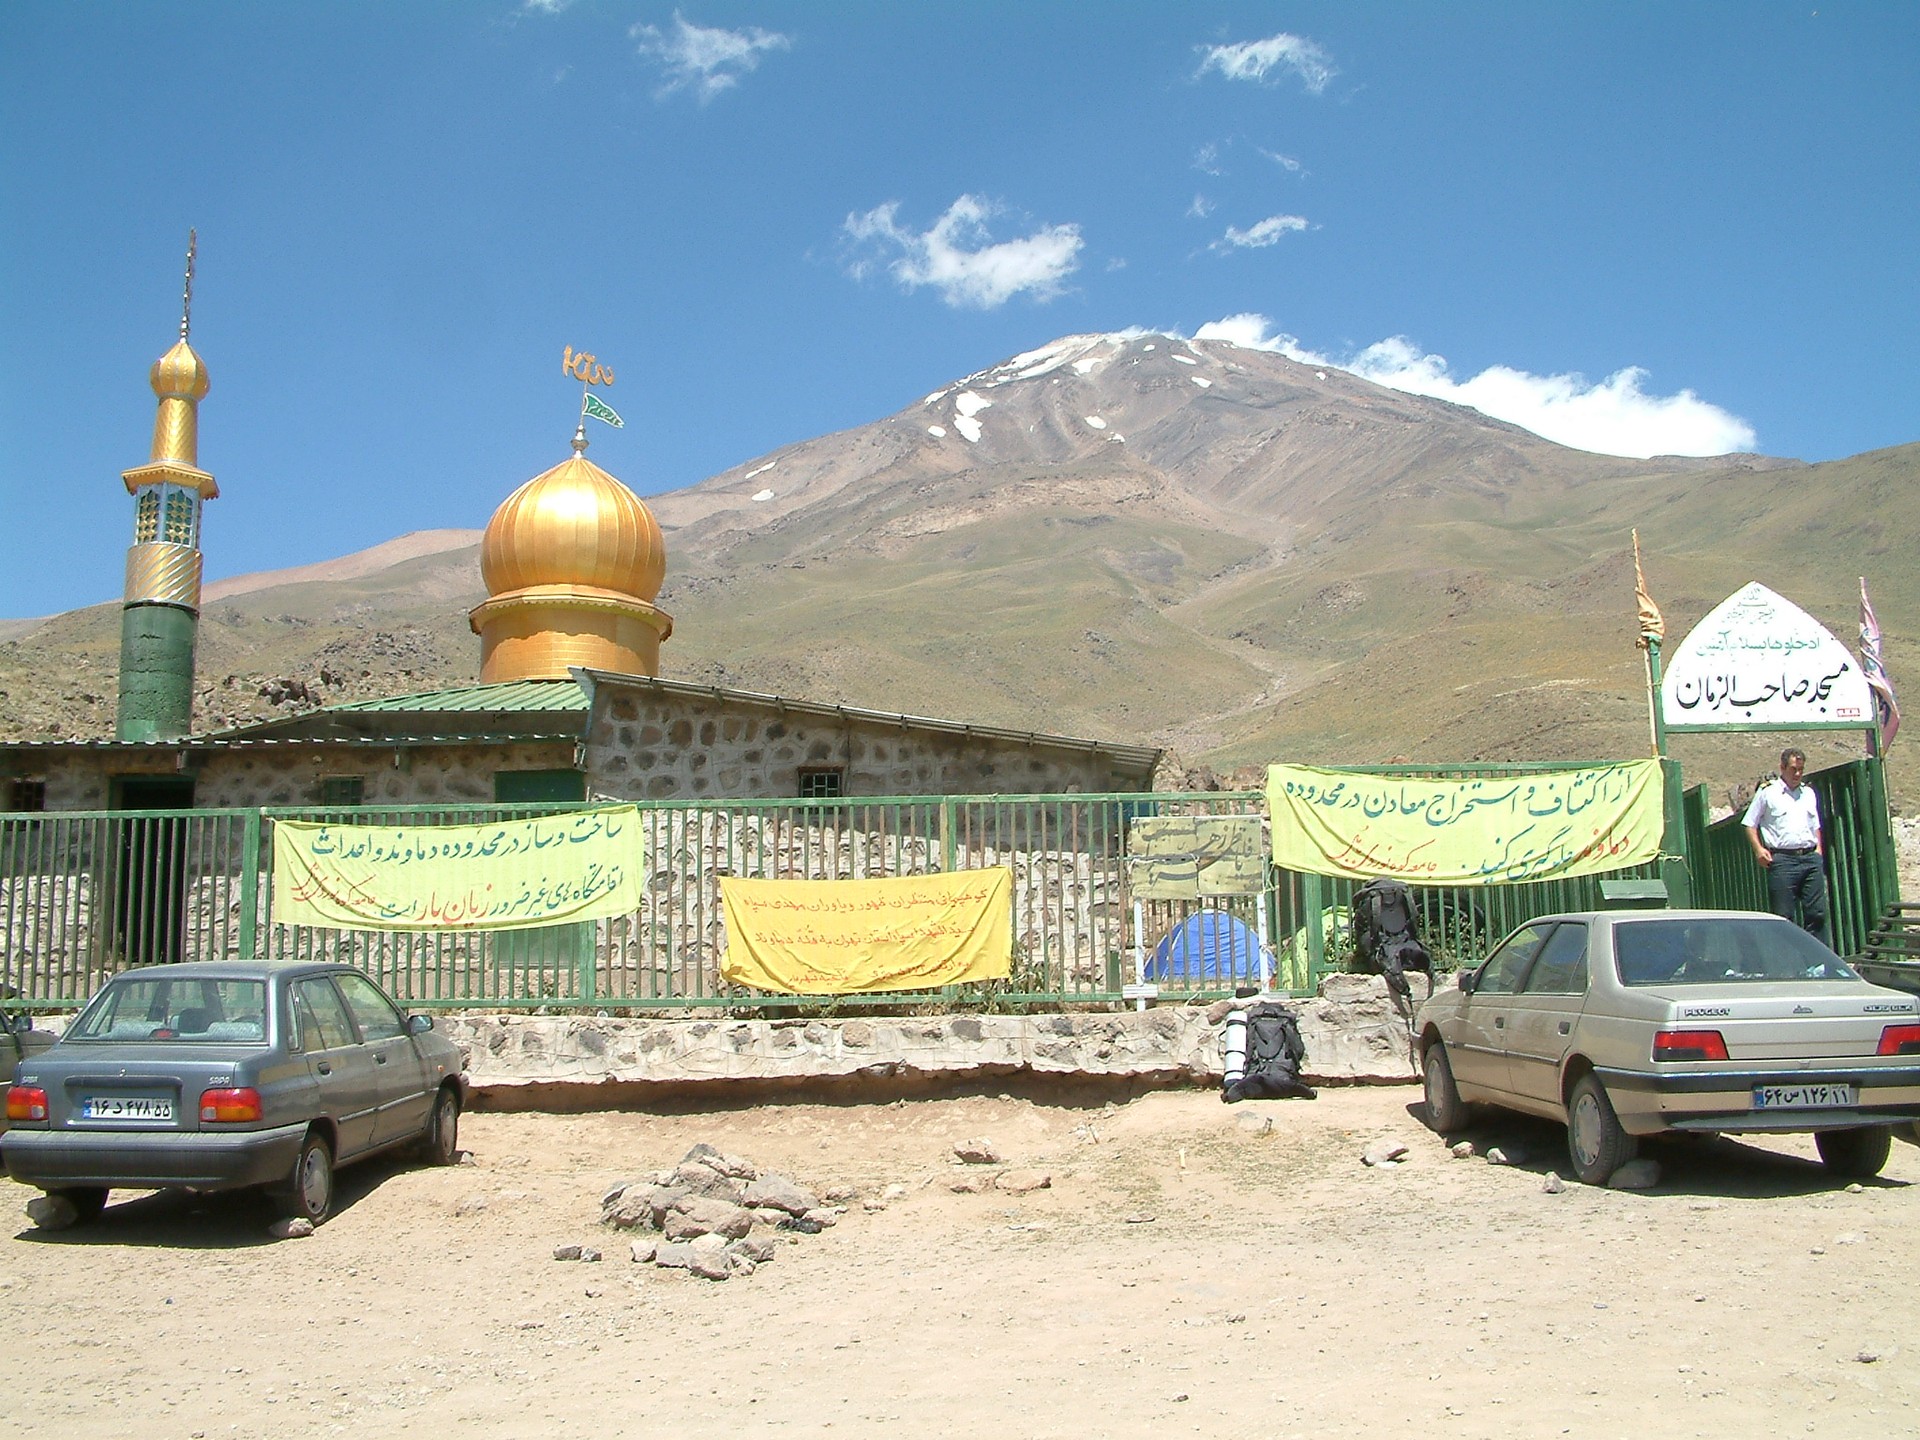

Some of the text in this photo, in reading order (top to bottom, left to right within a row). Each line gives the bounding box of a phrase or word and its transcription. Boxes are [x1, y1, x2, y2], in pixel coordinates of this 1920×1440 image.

[1676, 662, 1849, 717] مسجد صاحب الزمان
[1286, 780, 1345, 807] محدوده
[1340, 792, 1361, 810] در
[1363, 785, 1427, 819] معادن
[1528, 765, 1616, 817] اکتشاف
[1611, 769, 1632, 804] از
[1425, 780, 1519, 827] استخراج
[311, 826, 373, 859] احداث
[441, 830, 506, 859] محدوده
[570, 815, 624, 844] ساخت
[387, 832, 438, 865] دماوند
[500, 836, 520, 857] در
[768, 899, 807, 912] مهدی
[1684, 1007, 1731, 1017] PEUGEOT
